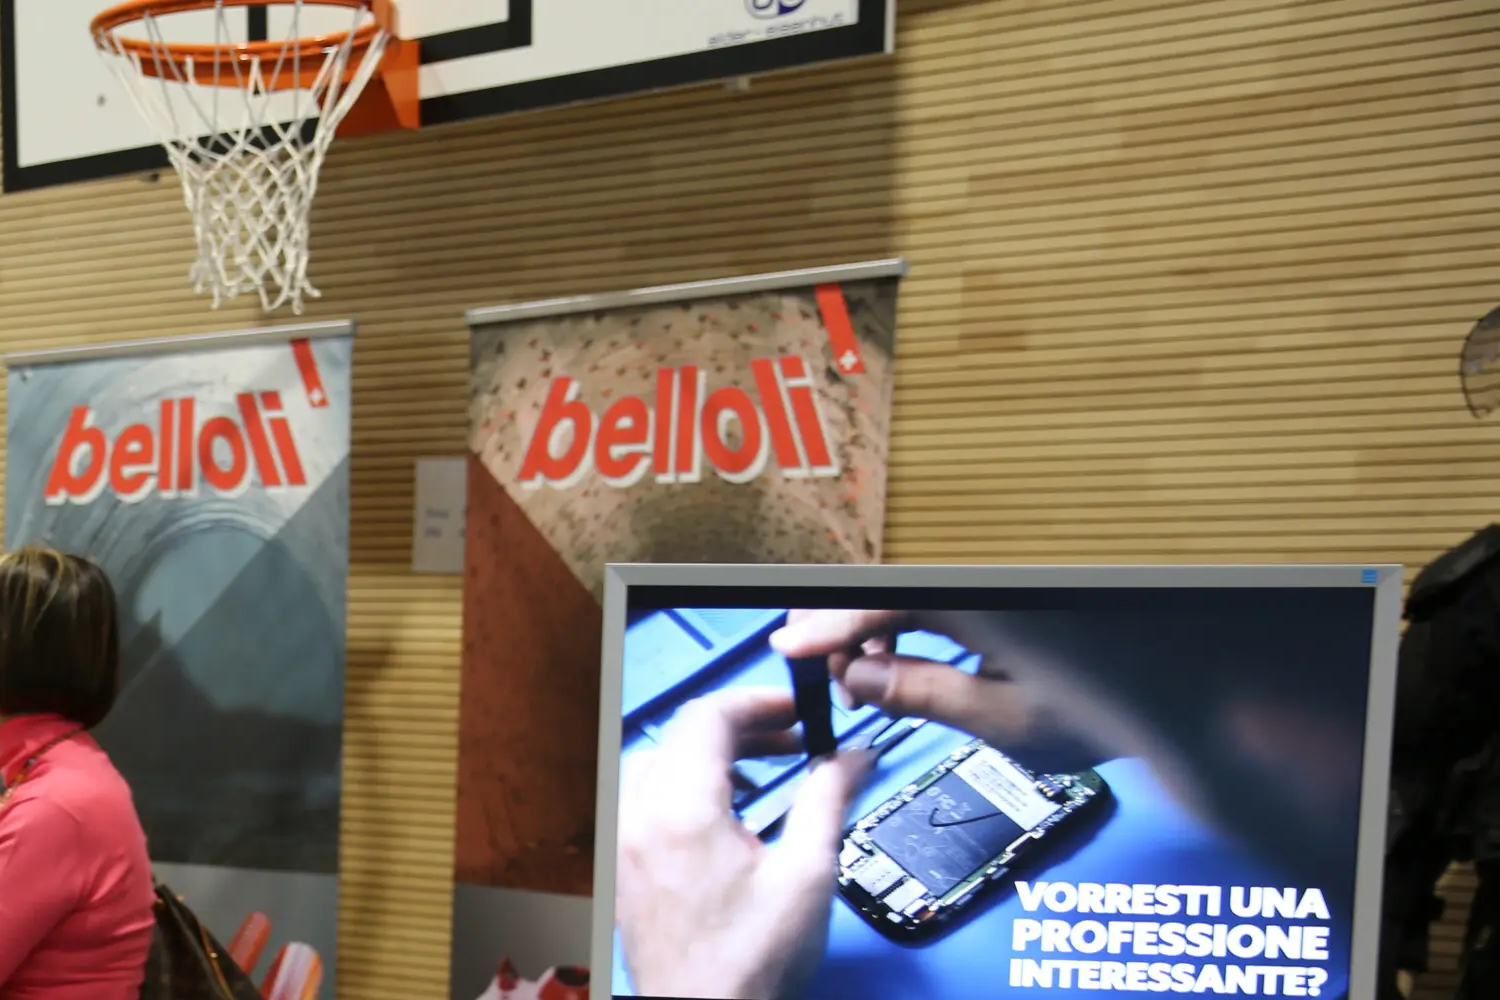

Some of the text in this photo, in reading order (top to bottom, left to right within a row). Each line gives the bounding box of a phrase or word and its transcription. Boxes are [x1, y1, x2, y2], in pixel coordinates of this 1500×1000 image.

[517, 354, 841, 490] belloli
[43, 389, 308, 506] belloli
[1014, 880, 1332, 920] VORRESTI UNA
[1011, 918, 1331, 961] PROFESSIONE
[1008, 958, 1329, 997] INTERESSANTE?
